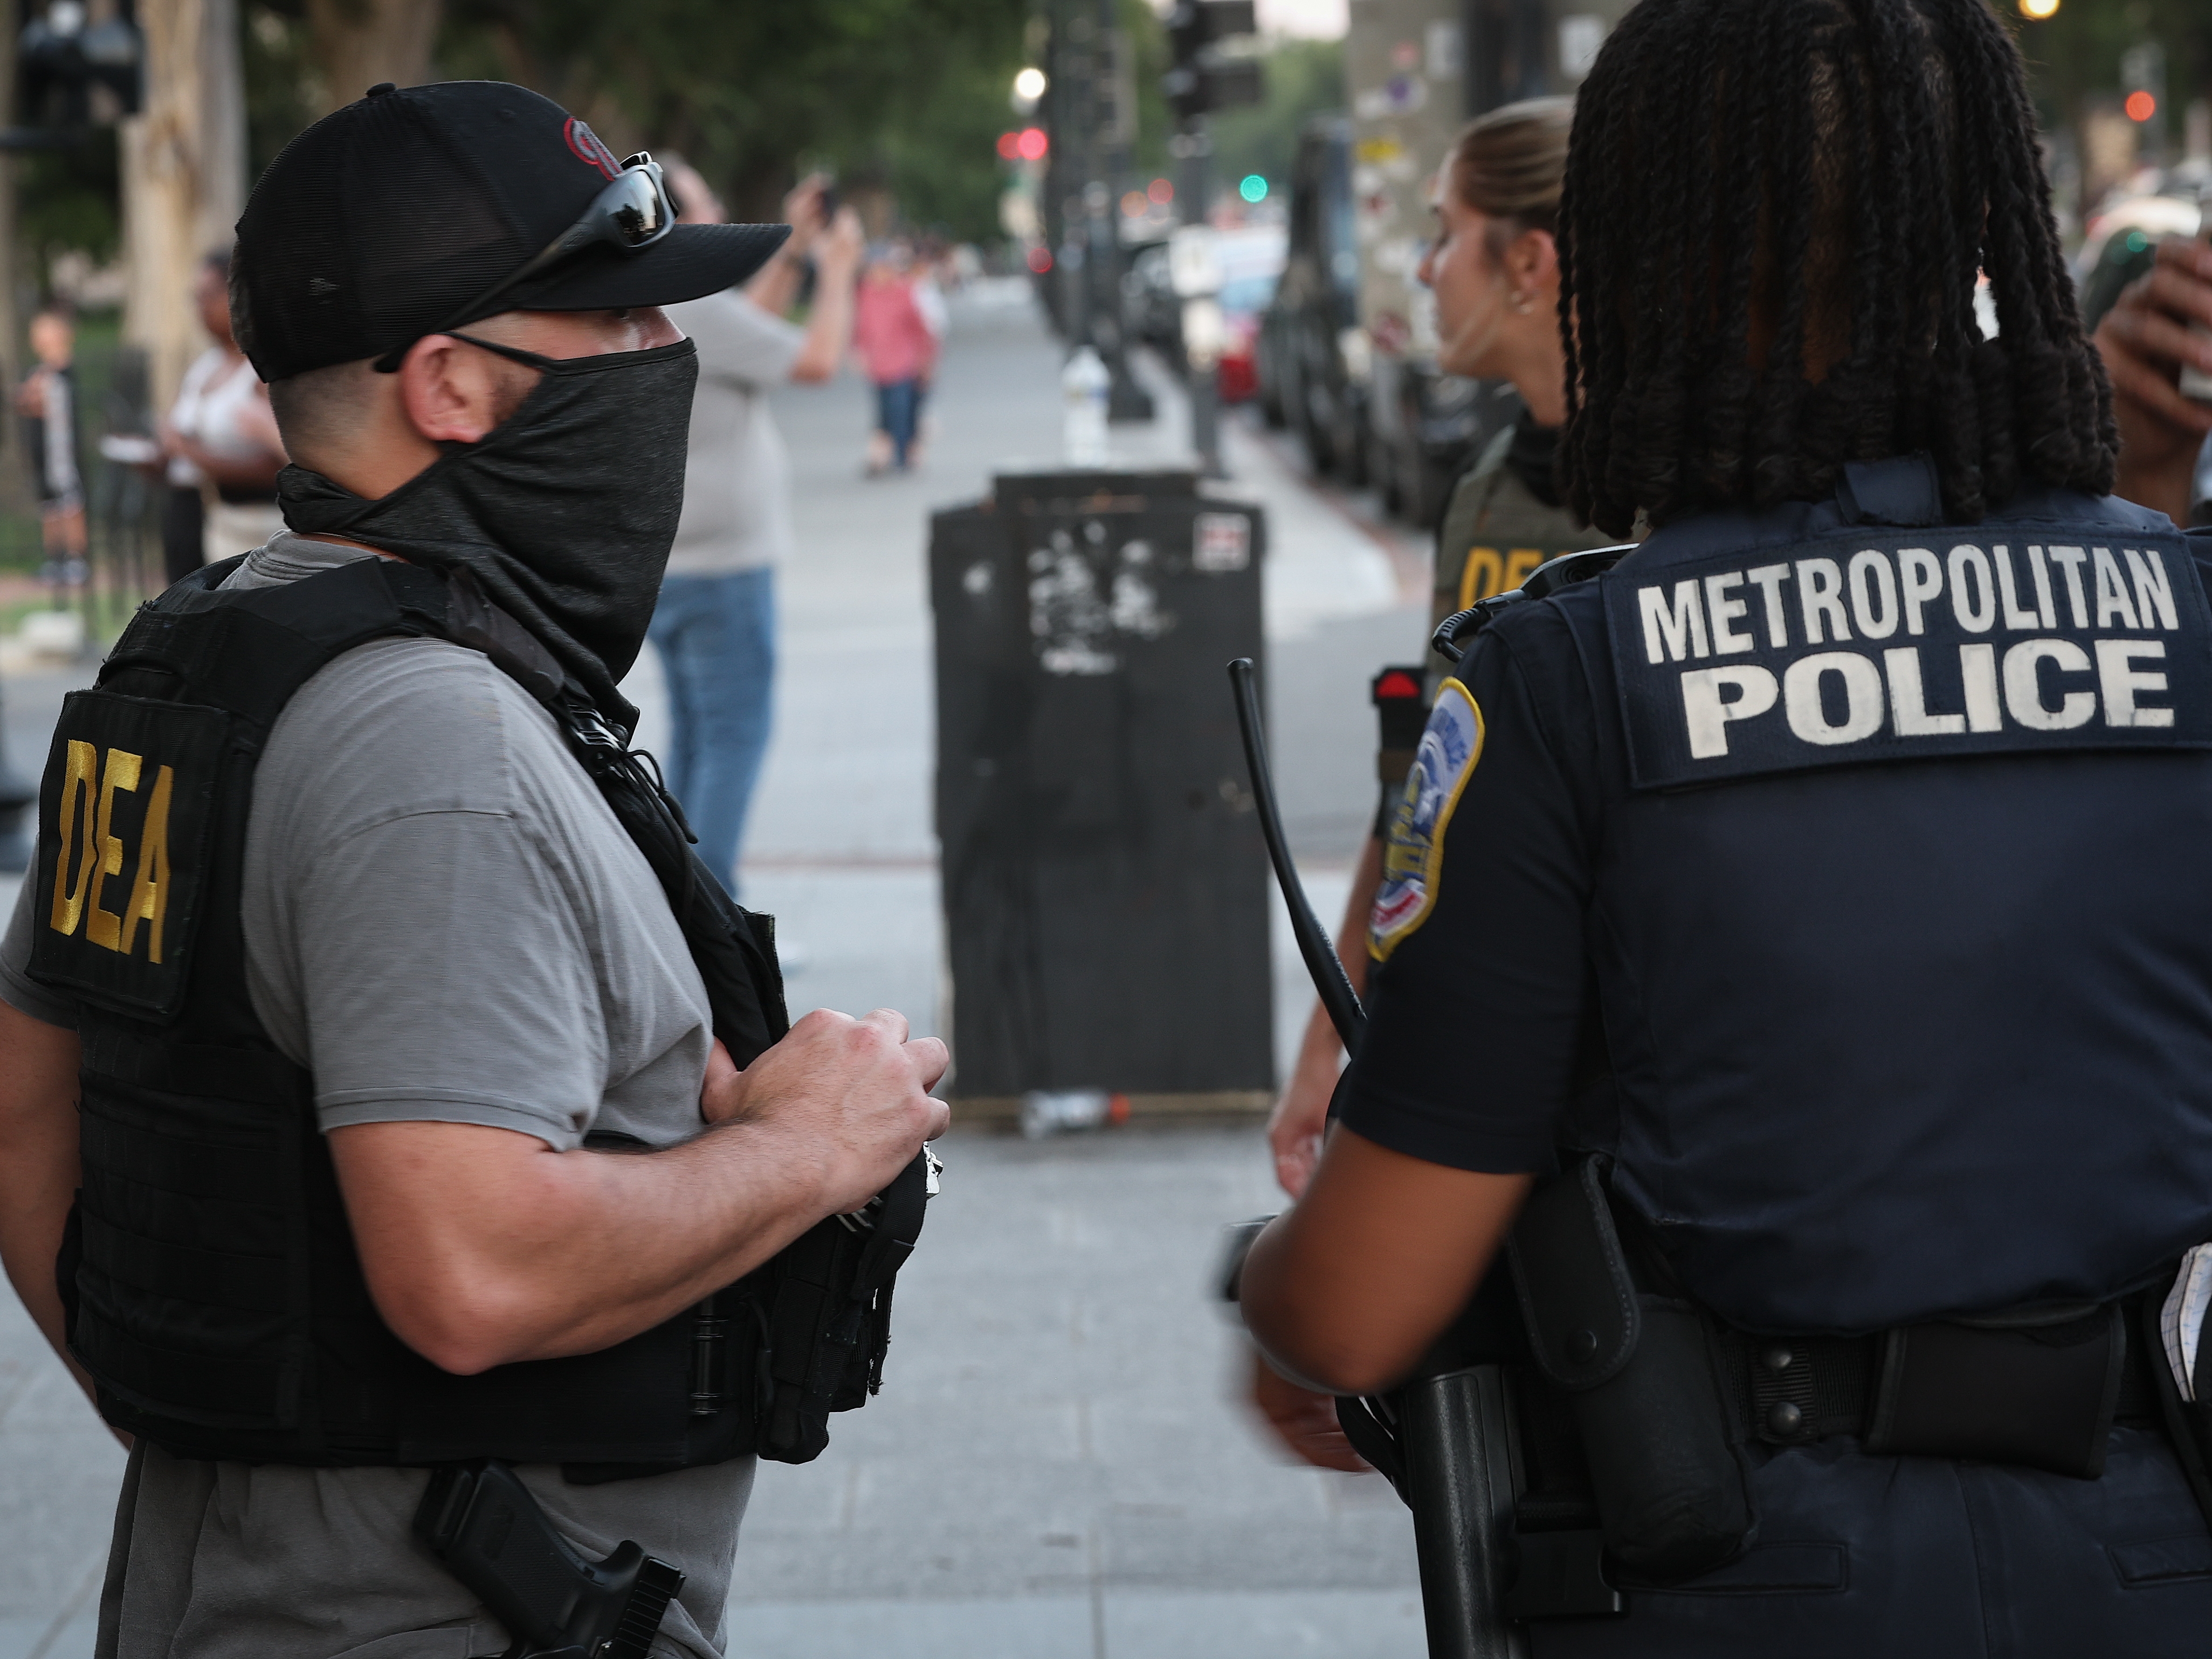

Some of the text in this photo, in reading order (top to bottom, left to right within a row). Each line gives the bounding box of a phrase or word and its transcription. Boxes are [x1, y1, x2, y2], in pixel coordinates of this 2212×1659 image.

[1458, 546, 1571, 611] DE
[1637, 543, 2179, 664] METROPOLITAN
[1680, 638, 2175, 759] POLICE
[50, 739, 174, 964] DEA
